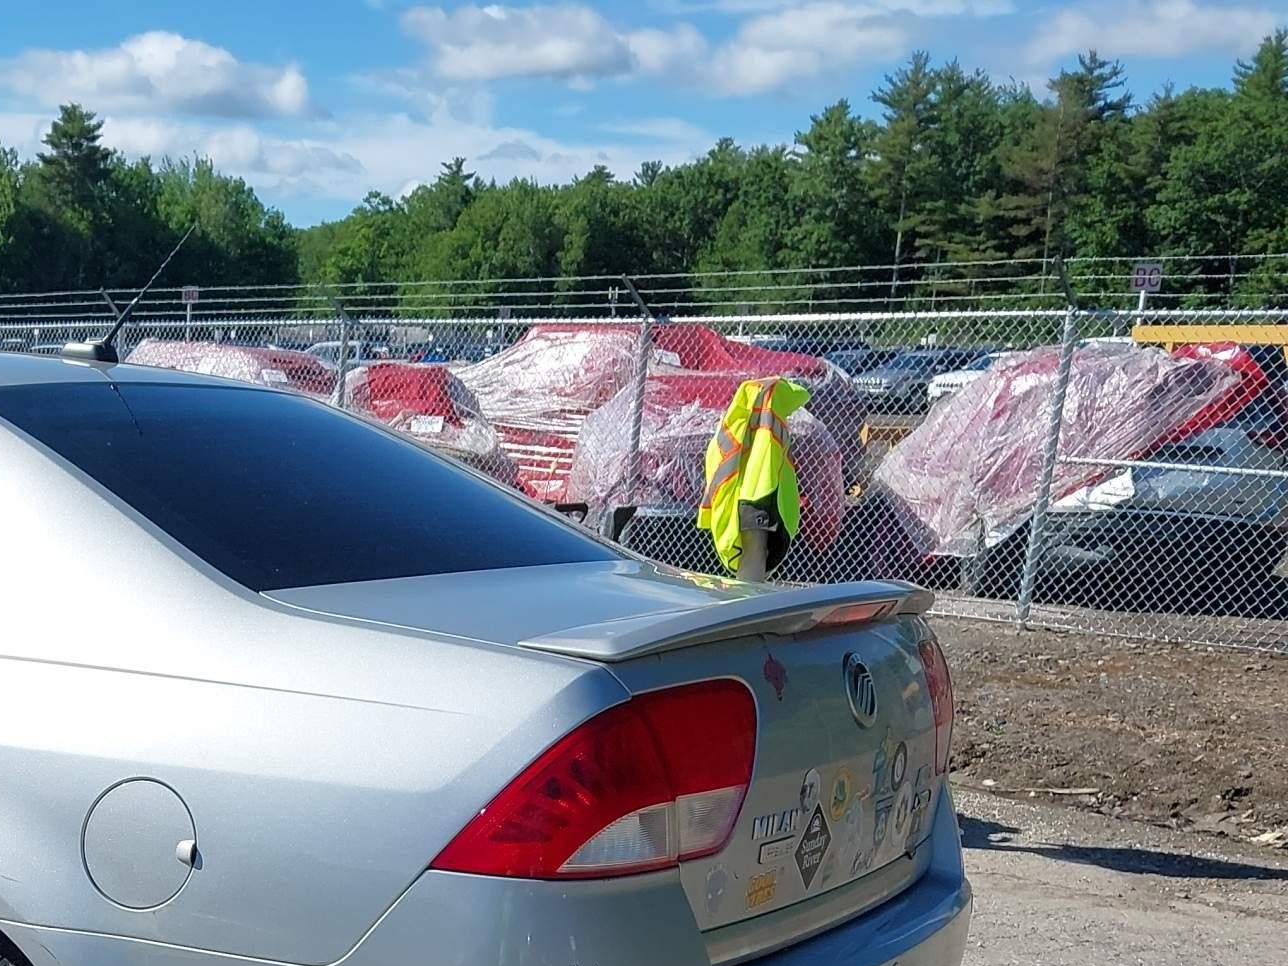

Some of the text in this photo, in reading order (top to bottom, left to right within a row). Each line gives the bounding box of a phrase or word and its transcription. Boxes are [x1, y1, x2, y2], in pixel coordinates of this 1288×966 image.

[1134, 266, 1161, 288] BC
[800, 833, 828, 856] Sunday
[801, 851, 822, 870] River
